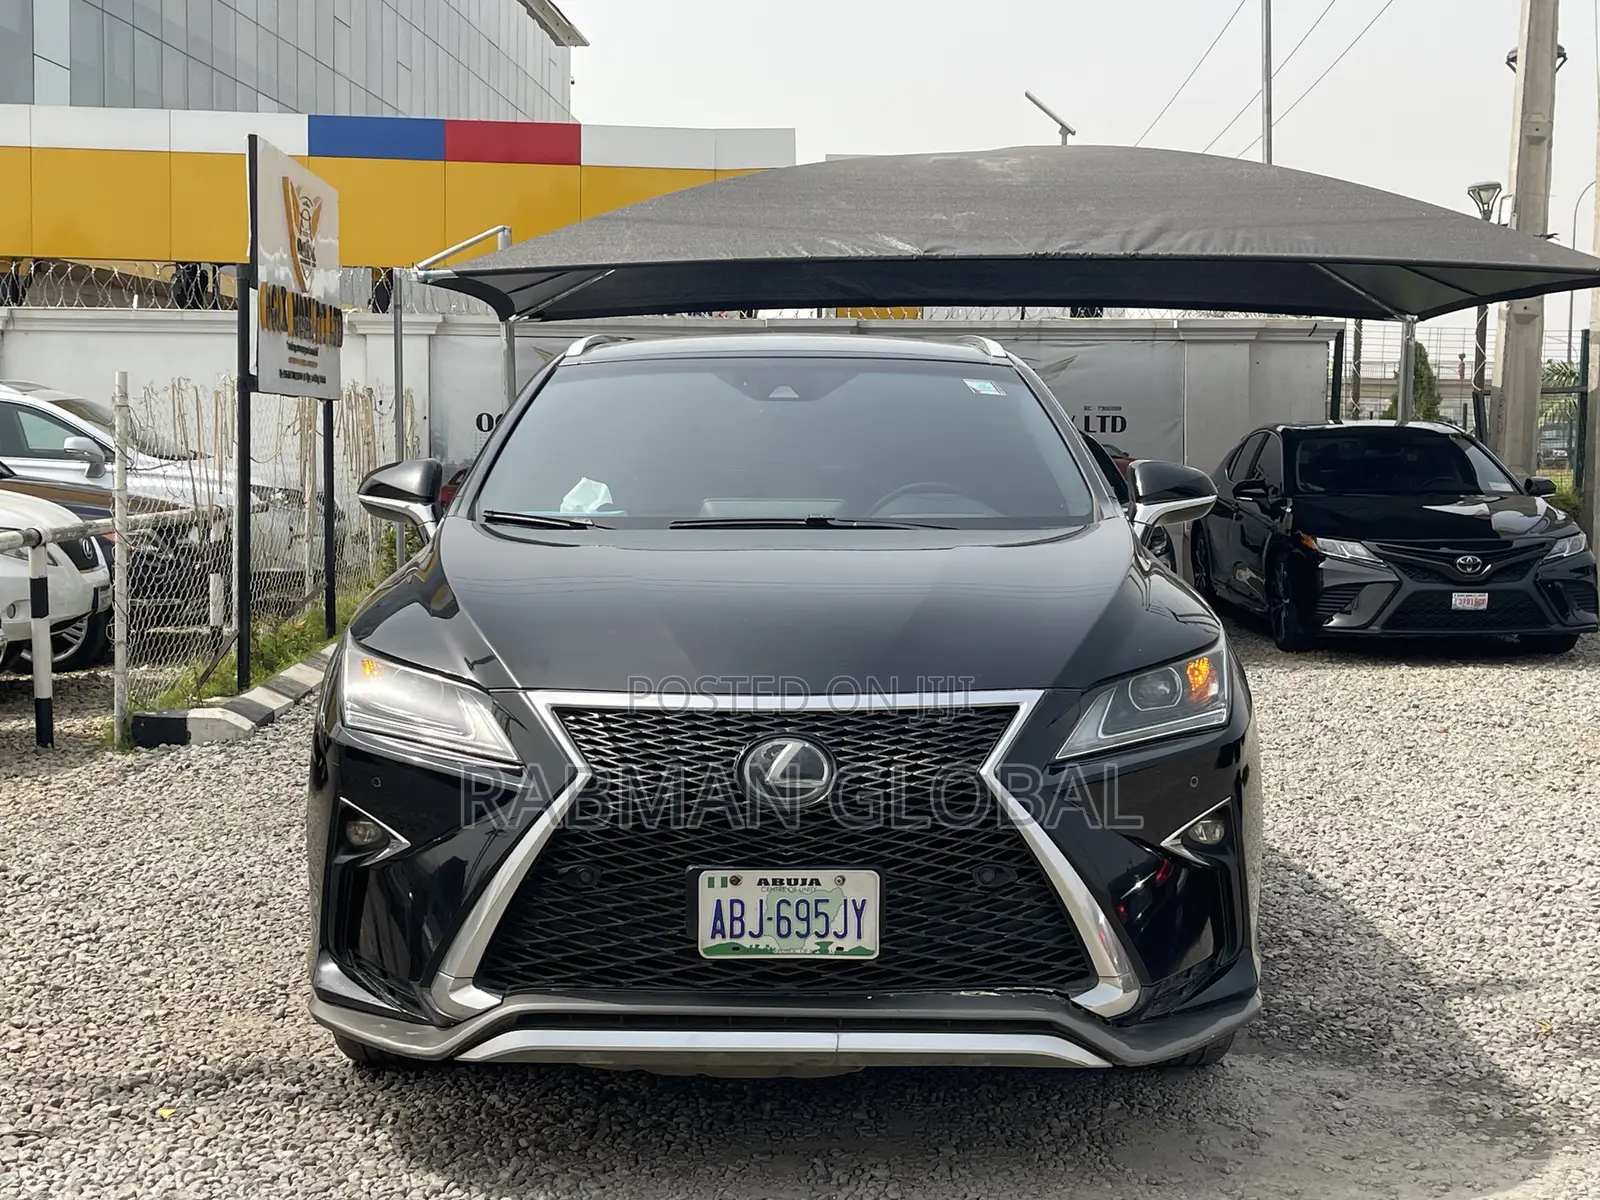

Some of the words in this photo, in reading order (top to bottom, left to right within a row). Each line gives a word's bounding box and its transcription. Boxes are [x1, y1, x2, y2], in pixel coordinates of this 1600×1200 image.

[1084, 415, 1127, 433] LTD
[757, 877, 822, 886] ABUJA
[710, 898, 867, 940] ABJ-695JY
